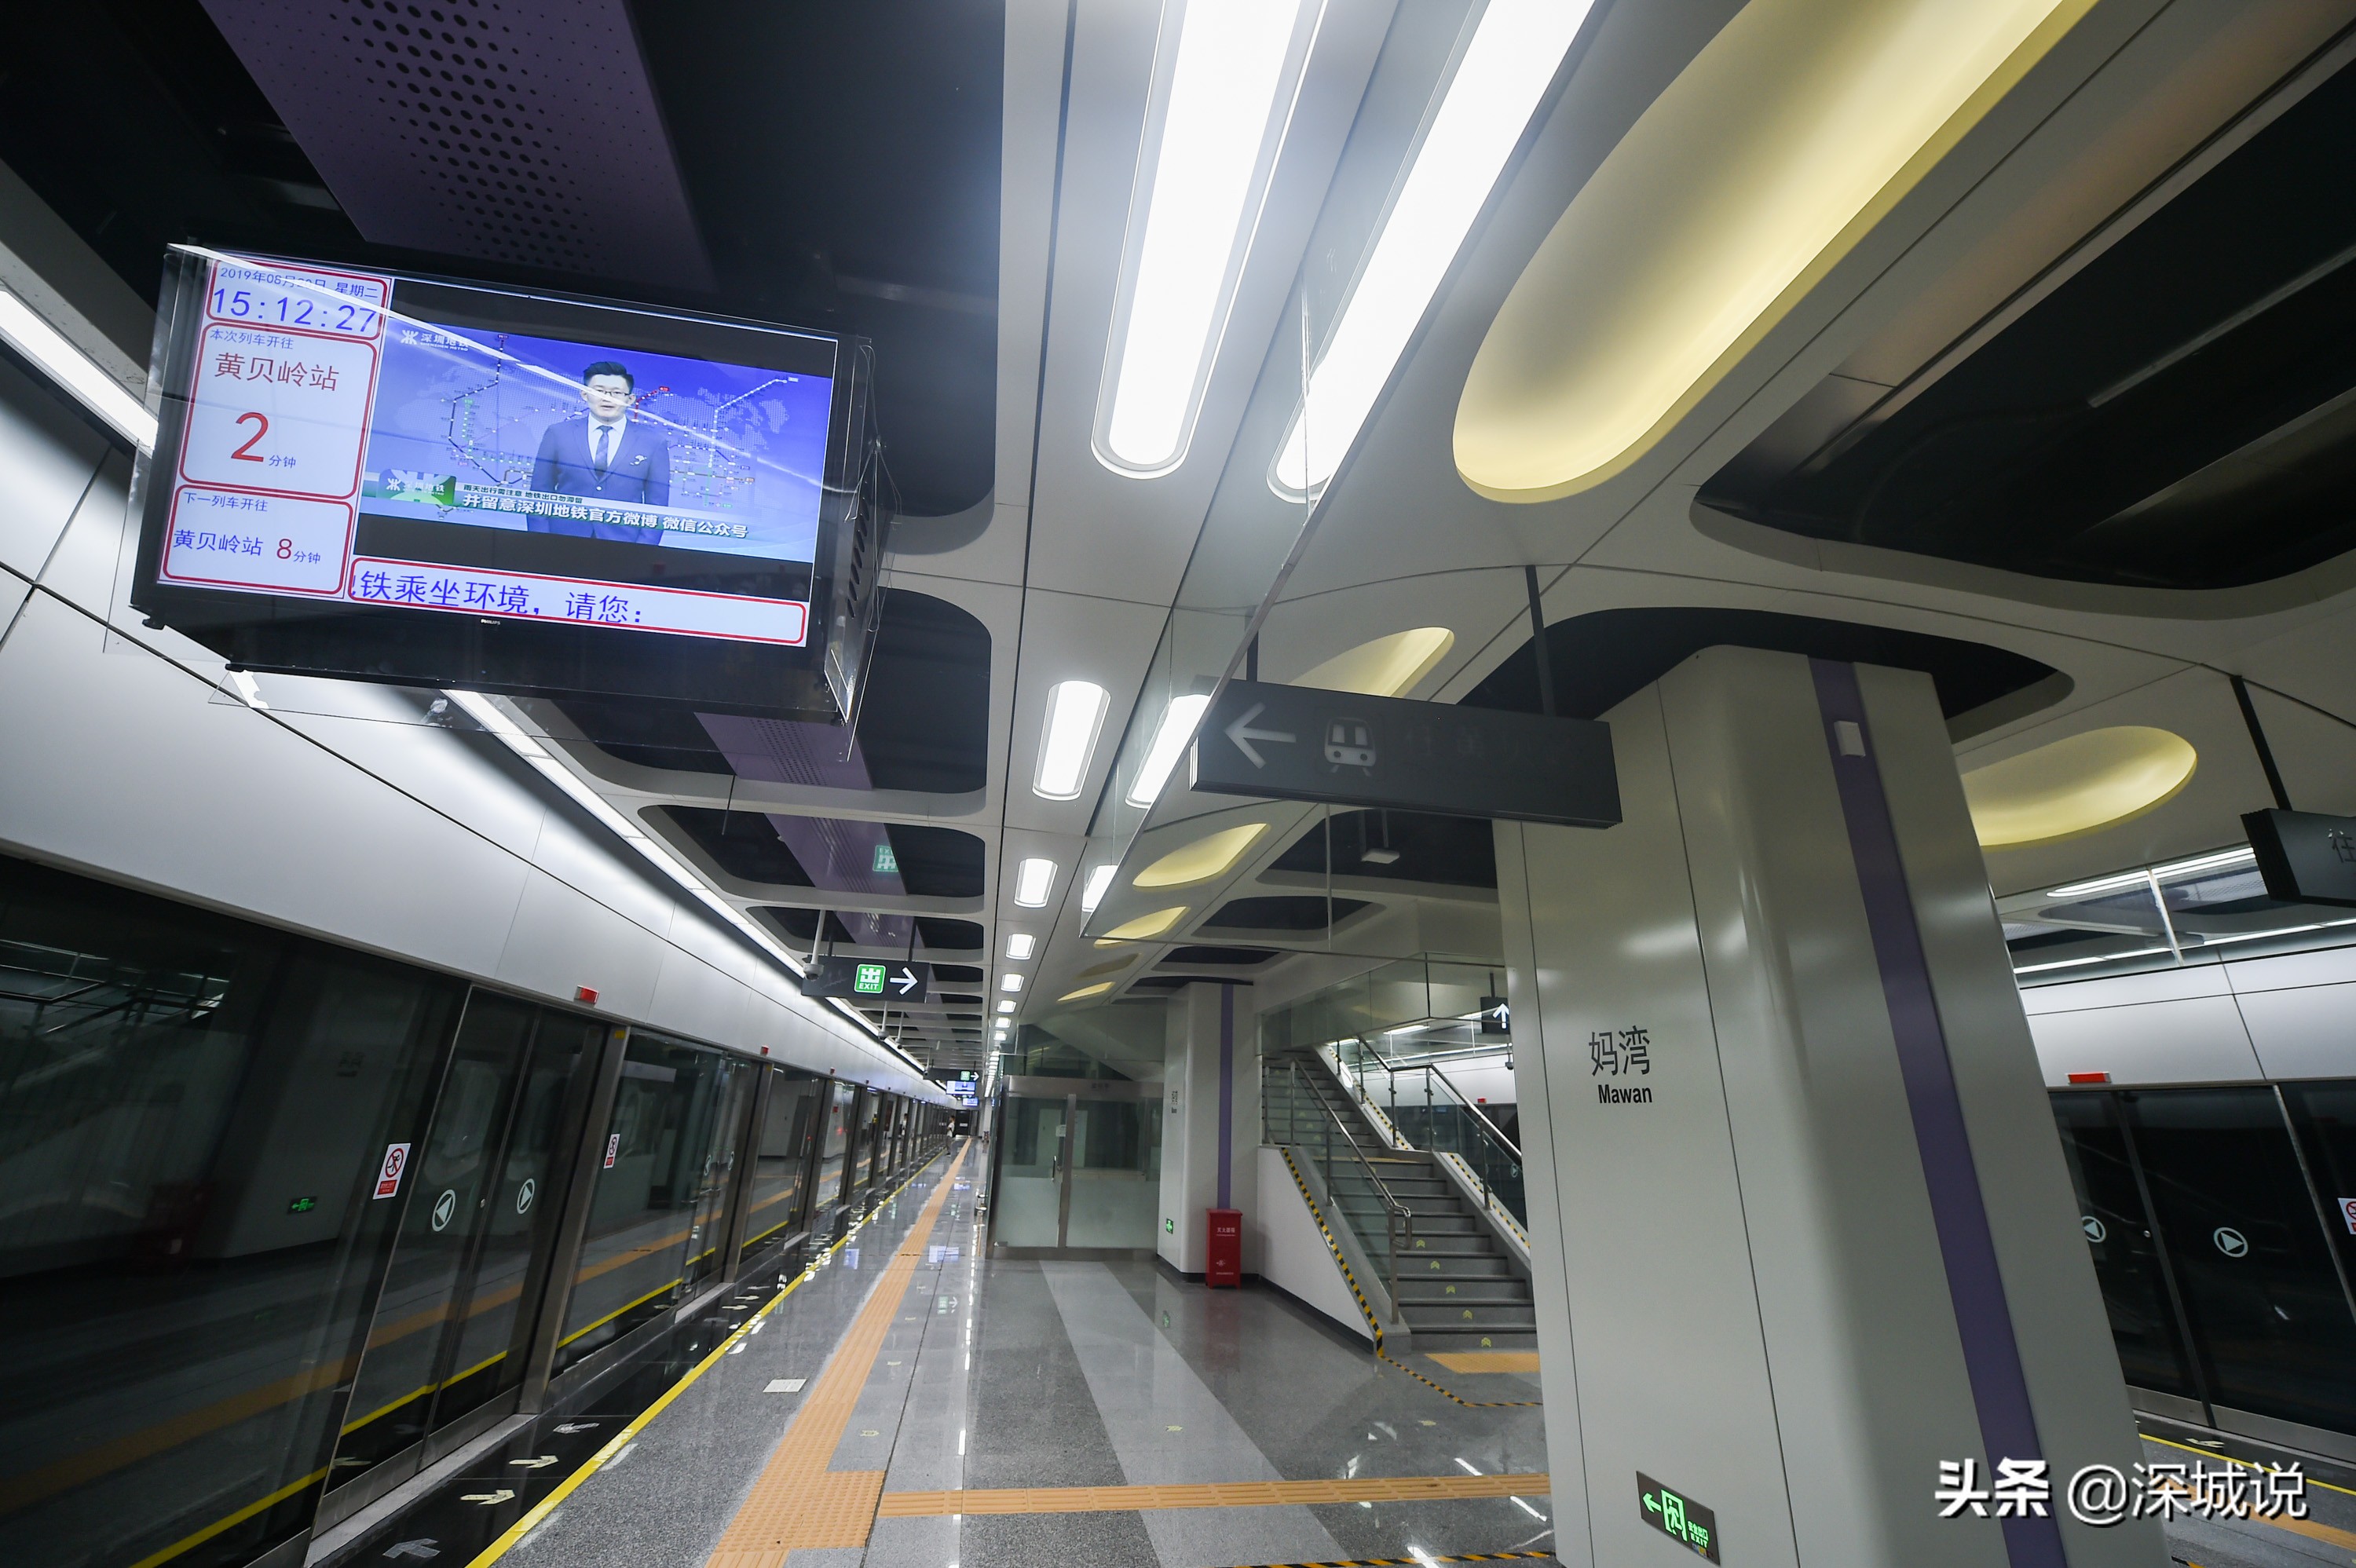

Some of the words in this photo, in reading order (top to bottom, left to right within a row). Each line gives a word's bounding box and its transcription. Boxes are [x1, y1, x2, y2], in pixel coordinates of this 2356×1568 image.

[221, 268, 327, 288] 2019年08月日
[335, 282, 379, 298] 星期二
[214, 288, 377, 332] 15:12:27
[210, 329, 294, 350] 本次列车开往
[214, 352, 340, 392] 黄贝岭站
[184, 492, 269, 513] 下一列车开往
[463, 493, 659, 529] 并留意深圳地铁官方微博
[663, 516, 748, 539] 微信公众号
[174, 530, 264, 557] 黄贝岭站
[1588, 1025, 1650, 1076] 妈湾
[1598, 1084, 1652, 1103] Mawan
[1690, 1532, 1707, 1548] EXIT
